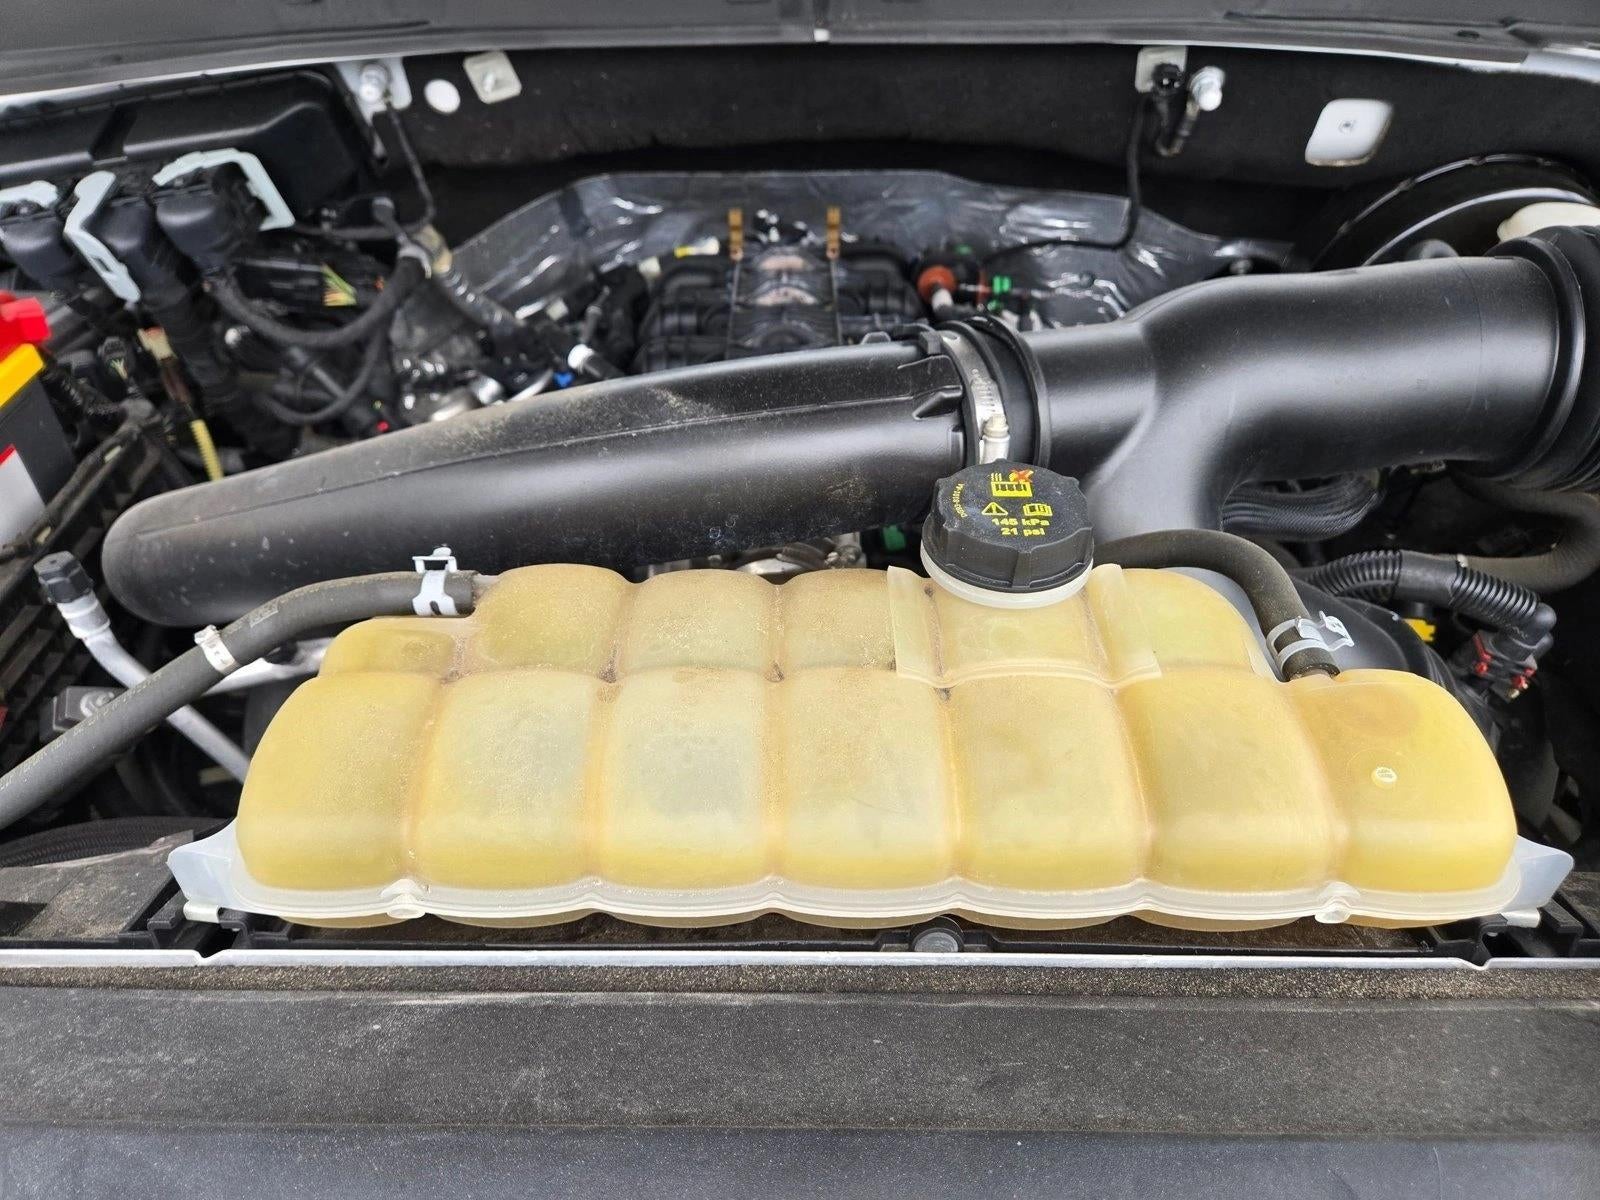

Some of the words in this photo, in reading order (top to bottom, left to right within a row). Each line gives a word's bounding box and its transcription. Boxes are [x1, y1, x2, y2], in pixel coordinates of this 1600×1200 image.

[991, 517, 1019, 526] 145
[1021, 517, 1050, 526] kPa
[1000, 527, 1019, 536] 21
[1022, 527, 1046, 537] psi
